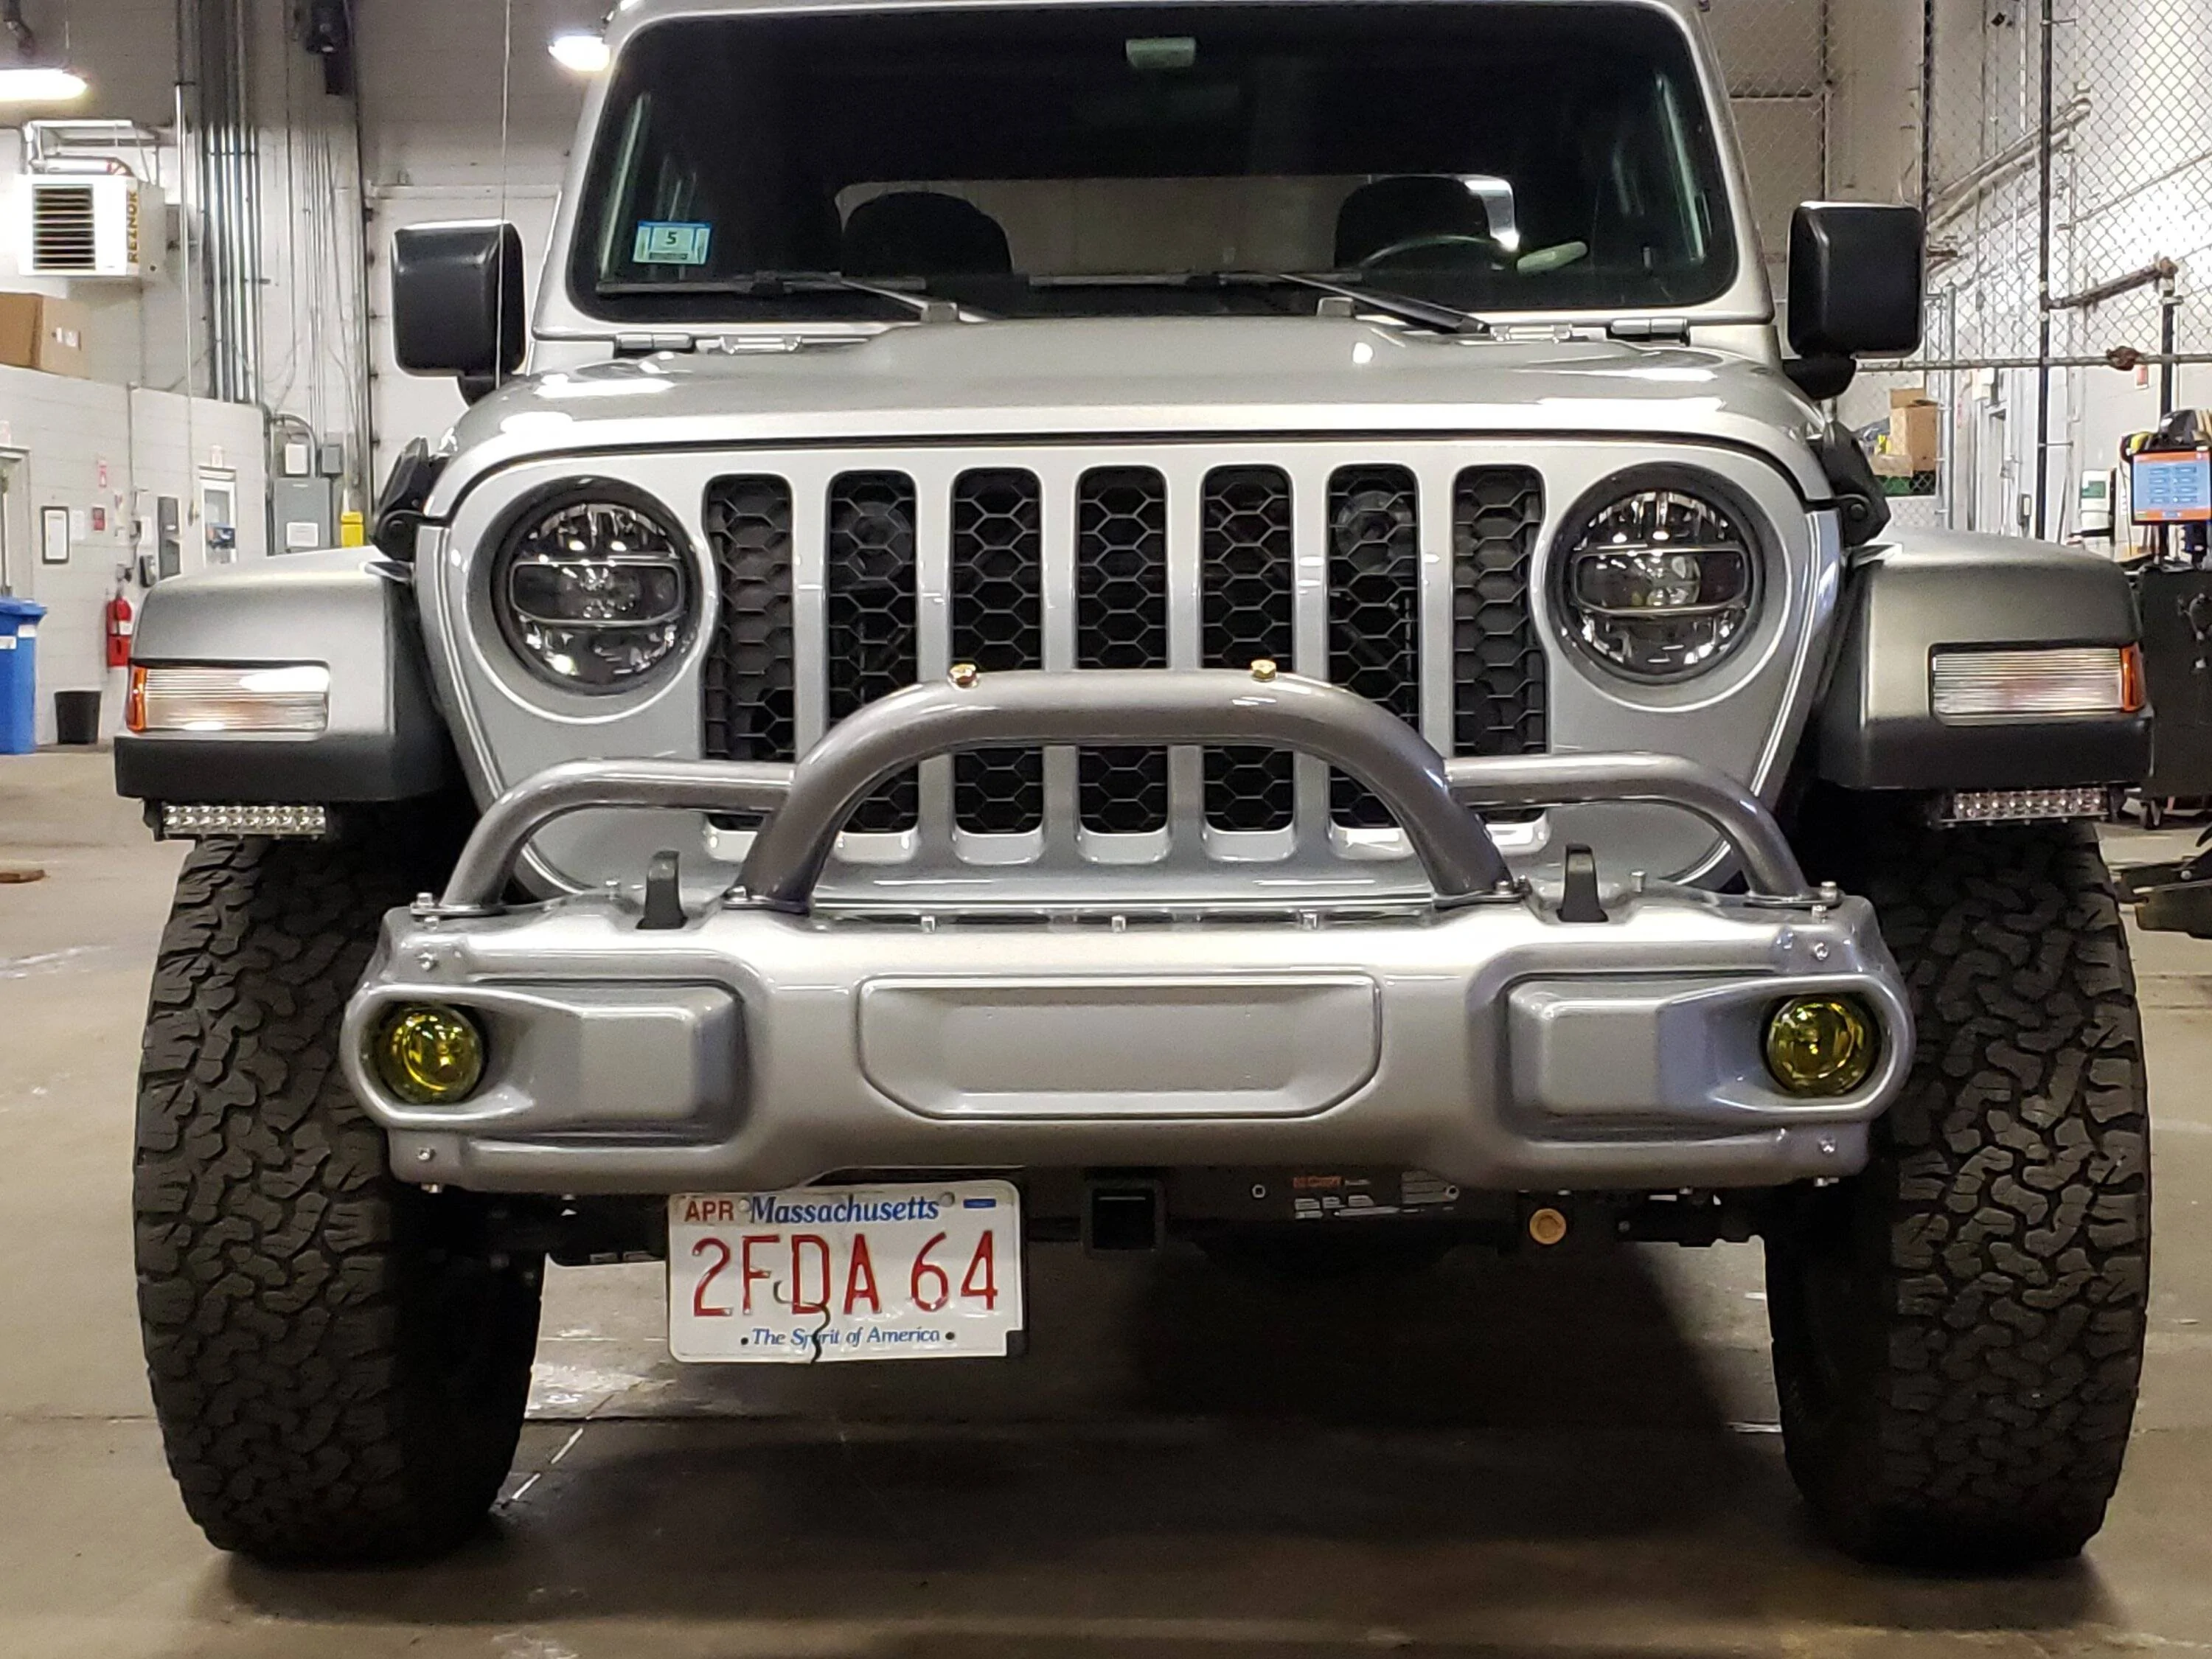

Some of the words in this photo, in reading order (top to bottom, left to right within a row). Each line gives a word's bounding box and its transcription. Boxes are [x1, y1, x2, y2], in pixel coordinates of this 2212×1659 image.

[666, 231, 677, 245] 5
[684, 1200, 734, 1222] APR
[750, 1194, 939, 1224] Massachusetts
[692, 1233, 883, 1317] 2FDA
[911, 1229, 998, 1312] 64
[752, 1327, 786, 1346] The
[846, 1326, 863, 1348] of
[866, 1326, 941, 1343] America
